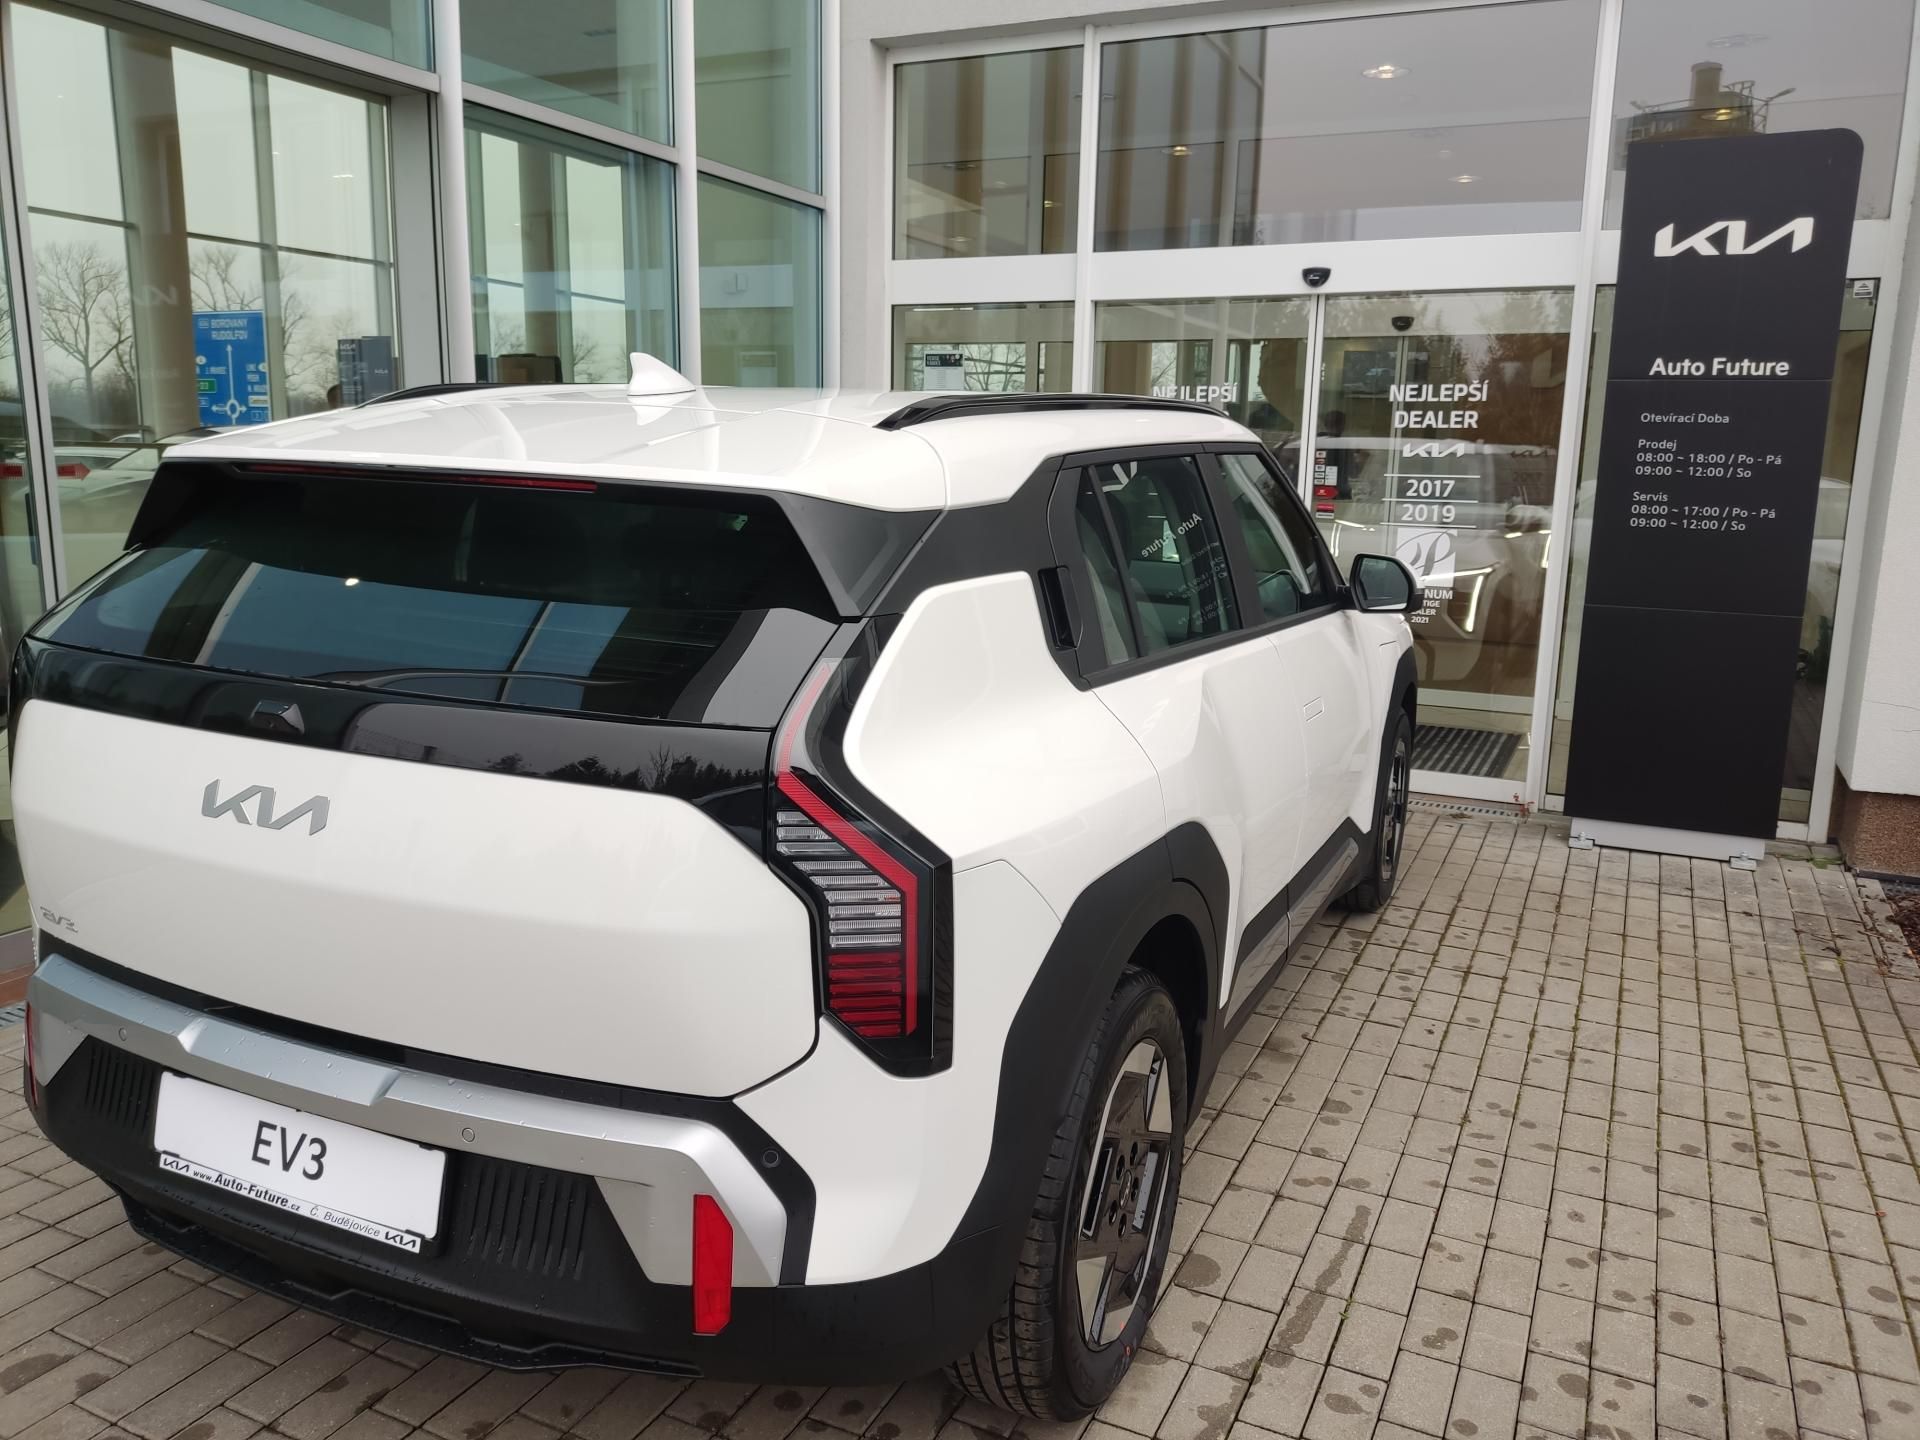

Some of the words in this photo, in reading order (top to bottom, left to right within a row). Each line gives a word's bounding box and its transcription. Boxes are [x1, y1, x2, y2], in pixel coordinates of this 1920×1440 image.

[1653, 216, 1815, 257] KIA
[1649, 357, 1706, 376] Auto
[1711, 357, 1790, 376] Future
[1389, 379, 1489, 402] NEJLEPŠÍ
[1394, 410, 1478, 429] DEALER
[1640, 411, 1696, 424] Otevírací
[1697, 412, 1730, 424] Doba
[1402, 442, 1465, 458] KIA
[1637, 438, 1678, 452] Prodej
[1636, 452, 1674, 463] 08:00
[1689, 453, 1726, 464] 18:00
[1737, 454, 1754, 465] Po
[1765, 454, 1782, 465] Pá
[1635, 465, 1673, 476] 09:00
[1688, 466, 1724, 477] 12:00
[1736, 467, 1752, 478] So
[1406, 479, 1455, 497] 2017
[1632, 491, 1669, 502] Servis
[1401, 503, 1456, 523] 2019
[1631, 504, 1669, 515] 08:00
[1683, 506, 1720, 517] 17:00
[1732, 507, 1749, 518] Po
[1759, 508, 1776, 519] Pá
[1629, 517, 1667, 528] 09:00
[1682, 519, 1719, 530] 12:00
[1730, 520, 1746, 531] So
[1411, 616, 1430, 624] 2021
[201, 778, 330, 836] KIA
[251, 1119, 327, 1181] EV3
[163, 1157, 190, 1173] KIA
[193, 1173, 301, 1212] www.Auto-Future.cz
[310, 1205, 320, 1218] Č.
[323, 1211, 381, 1237] Budějovice
[384, 1230, 416, 1250] KIA
